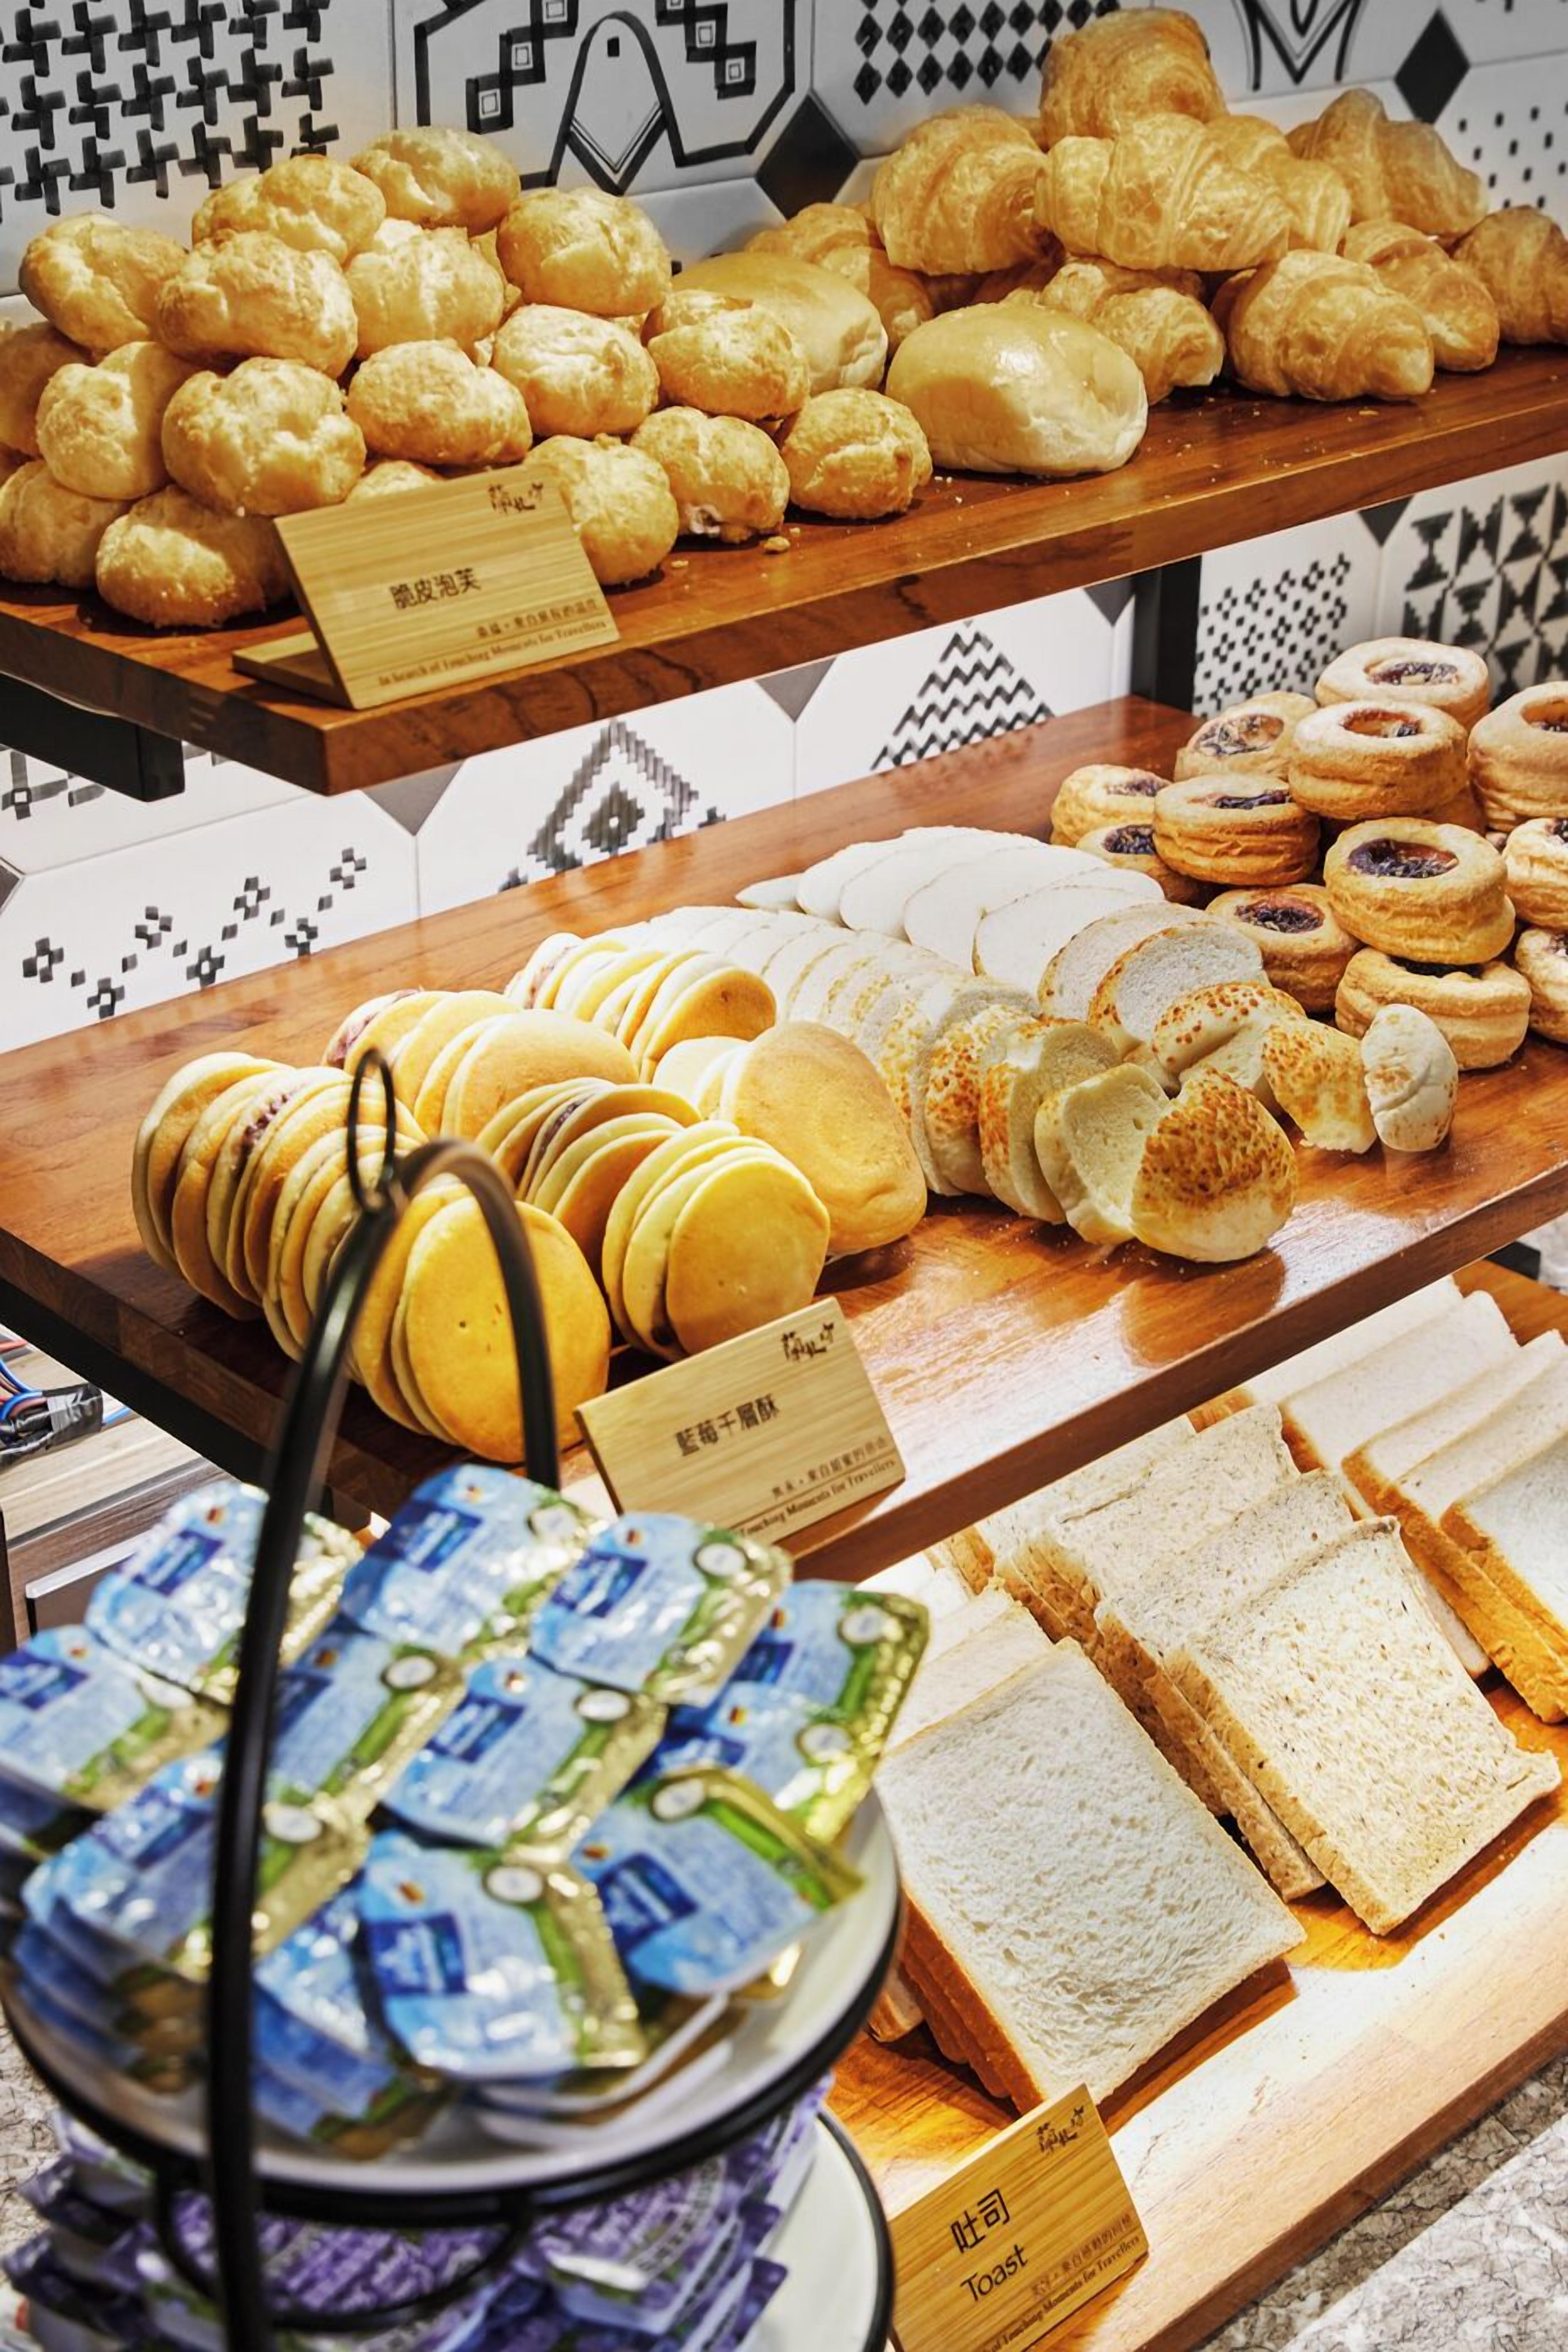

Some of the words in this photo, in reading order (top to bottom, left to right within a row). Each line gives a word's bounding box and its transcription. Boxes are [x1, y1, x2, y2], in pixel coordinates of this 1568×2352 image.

[389, 568, 481, 609] 脆皮泡芙
[675, 1393, 779, 1456] 藍莓千層酥
[848, 1460, 896, 1487] Travellers
[951, 2189, 1010, 2254] 吐司
[960, 2245, 1028, 2301] Toast
